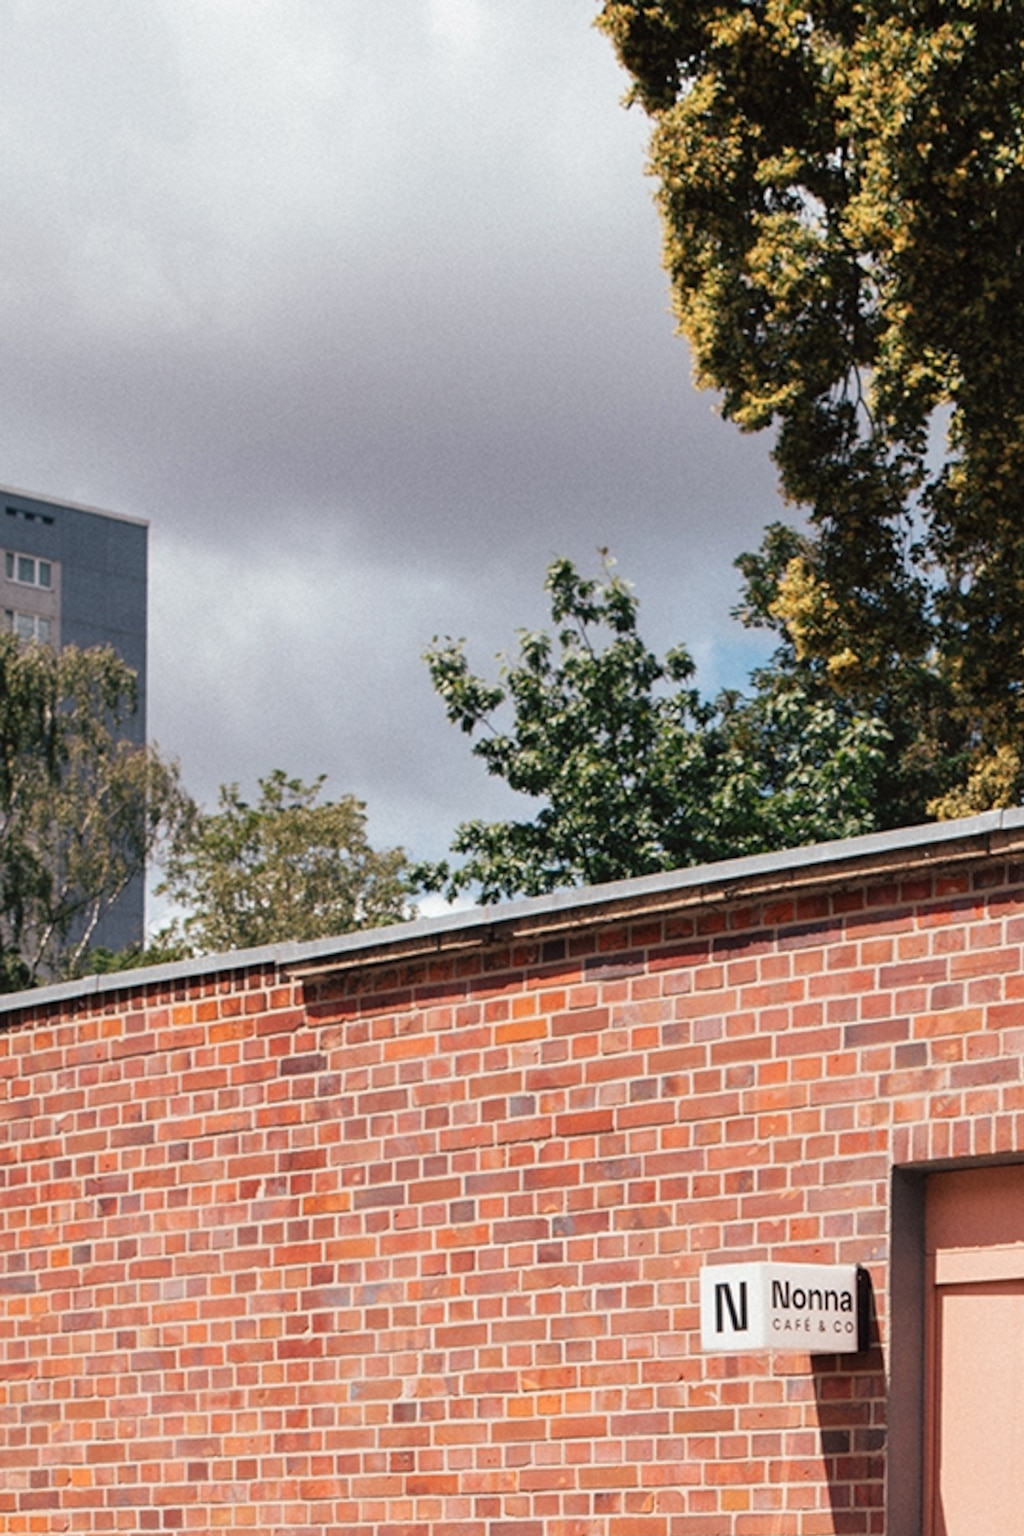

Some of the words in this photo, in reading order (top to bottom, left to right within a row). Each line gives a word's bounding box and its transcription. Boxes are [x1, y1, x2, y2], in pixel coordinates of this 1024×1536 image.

[715, 1282, 748, 1333] N
[772, 1280, 853, 1312] Nonna
[772, 1317, 811, 1332] CAFÉ
[819, 1321, 826, 1332] &
[833, 1321, 854, 1334] CO
